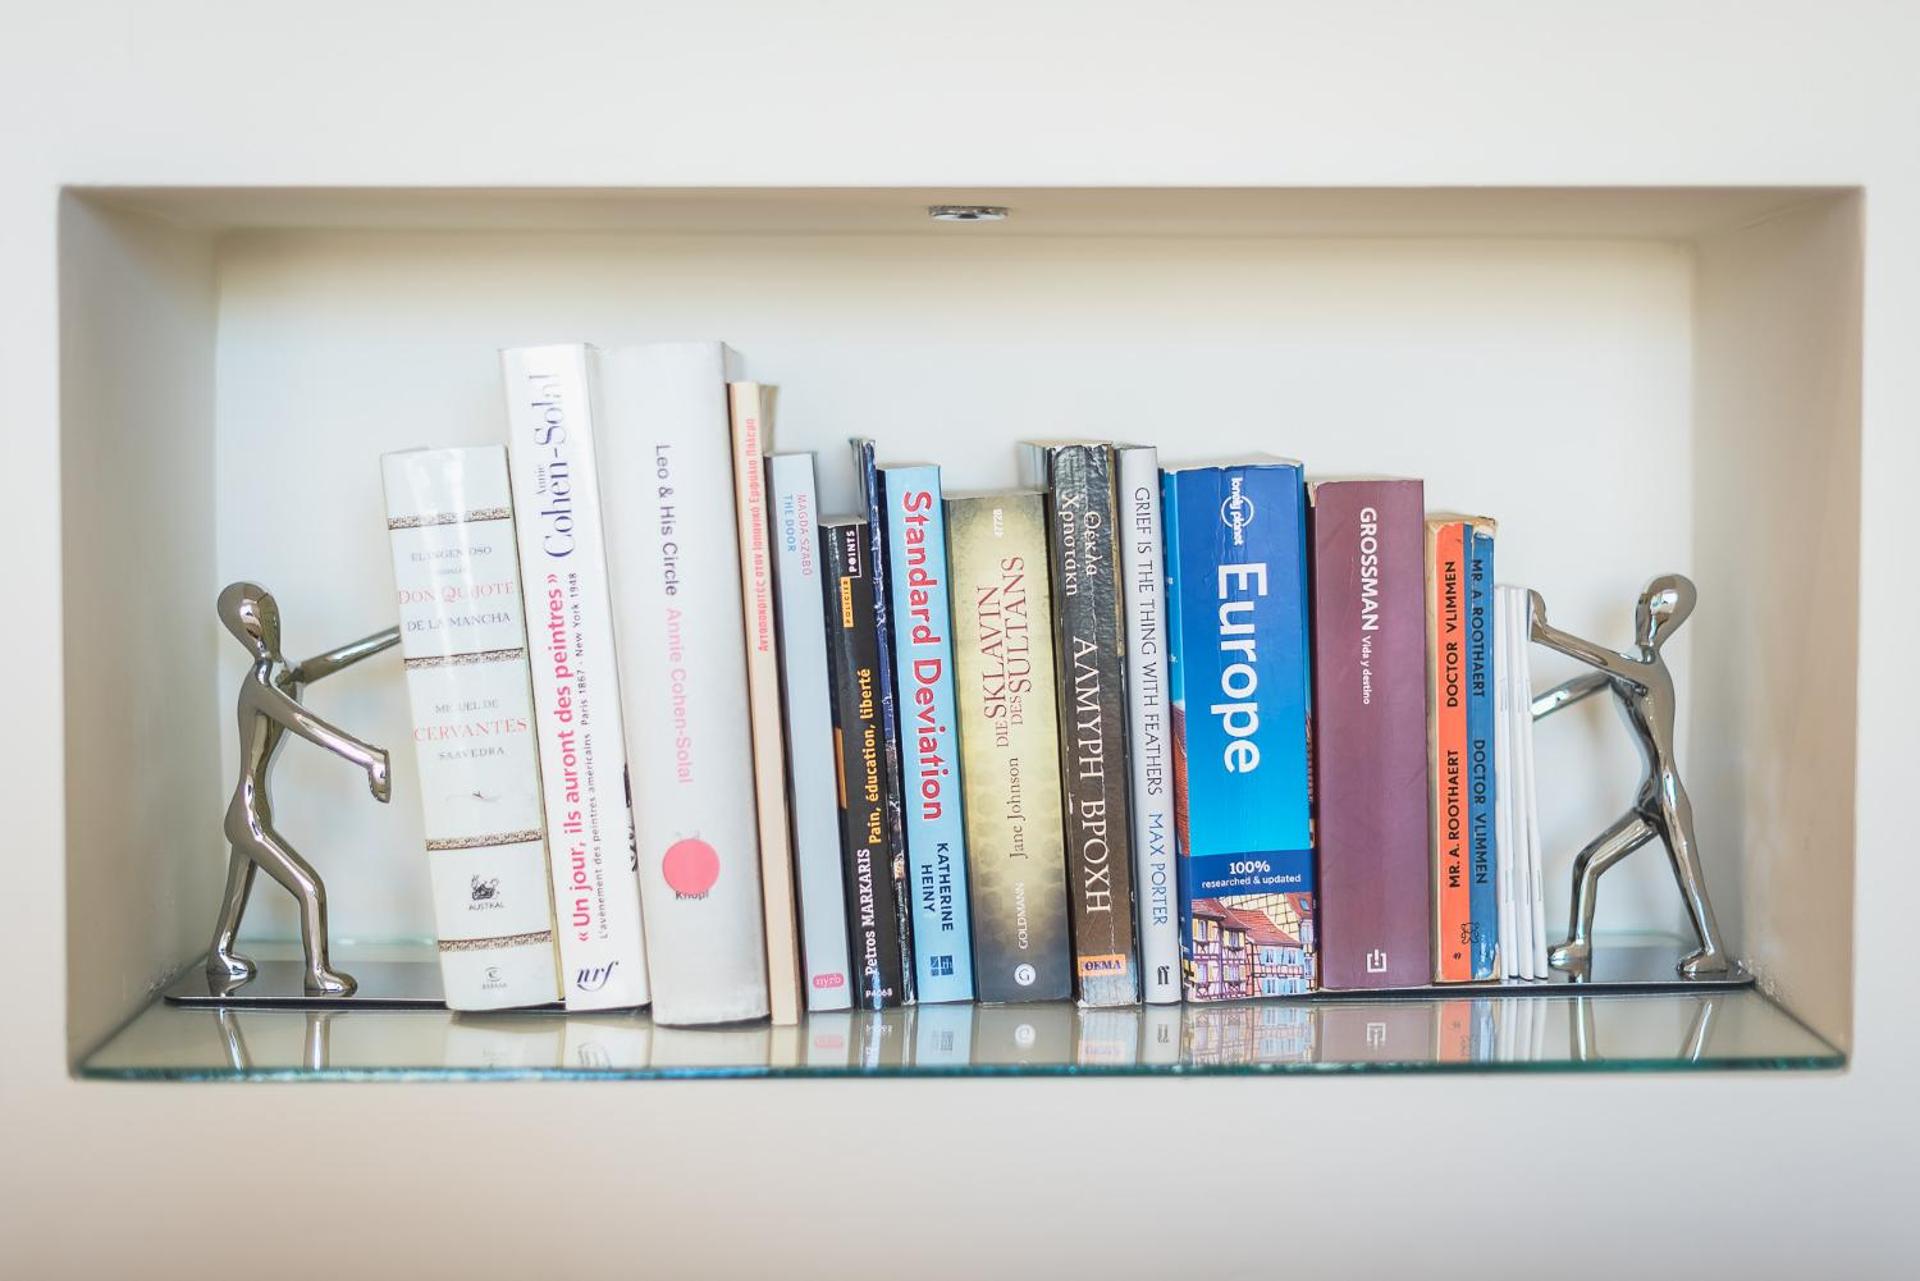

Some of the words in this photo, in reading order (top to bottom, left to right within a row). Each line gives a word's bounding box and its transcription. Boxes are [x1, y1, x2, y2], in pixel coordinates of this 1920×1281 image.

[528, 373, 575, 557] Cohen-Solal
[656, 444, 670, 479] Leo
[659, 486, 673, 498] &
[783, 495, 794, 516] THE
[1135, 487, 1152, 535] GRIEF
[1229, 477, 1244, 510] lonely
[660, 506, 675, 535] His
[797, 494, 809, 536] MAGDA
[1229, 510, 1245, 546] planet
[785, 520, 796, 553] DOOR
[846, 531, 857, 573] POINTS
[1137, 541, 1153, 555] IS
[568, 572, 578, 598] 1948
[663, 542, 679, 596] Circle
[903, 491, 942, 645] Standard
[1138, 560, 1154, 593] THE
[1360, 506, 1379, 631] GROSSMAN
[571, 604, 582, 628] York
[1445, 561, 1457, 633] VLIMMEN
[449, 612, 512, 628] MANCHA
[548, 589, 575, 679] peintres
[666, 608, 683, 662] Annie
[1000, 556, 1031, 694] SULTANS
[1139, 599, 1157, 655] THING
[575, 633, 584, 657] New
[976, 586, 1007, 719] SKLAVIN
[1361, 635, 1372, 658] Vida
[1472, 608, 1485, 698] ROOTHAERT
[577, 670, 587, 694] 1867
[1142, 663, 1158, 707] WITH
[1210, 562, 1268, 774] Europe
[1361, 667, 1372, 705] destino
[1446, 642, 1458, 707] DOCTOR
[554, 686, 573, 723] des
[580, 701, 590, 726] Paris
[857, 668, 874, 720] liberté
[1009, 695, 1024, 726] DES
[413, 718, 528, 743] CERVANTES
[671, 668, 693, 783] Cohen-Solal
[913, 658, 949, 821] Deviation
[996, 721, 1009, 748] DIE
[557, 730, 582, 803] auront
[863, 724, 877, 802] éducation,
[1143, 713, 1163, 796] FEATHERS
[1473, 739, 1487, 804] DOCTOR
[1006, 757, 1026, 821] Johnson
[1447, 750, 1460, 840] ROOTHAERT
[564, 811, 582, 834] ils
[588, 797, 602, 842] peintres
[868, 807, 882, 844] Pain,
[1149, 813, 1165, 857] MAX
[594, 846, 603, 865] des
[1009, 825, 1028, 859] Jane
[1448, 844, 1460, 857] A.
[1474, 813, 1488, 884] VLIMMEN
[568, 841, 593, 891] jour,
[936, 842, 954, 932] KATHERINE
[1202, 875, 1251, 889] researched
[1253, 876, 1261, 885] &
[1263, 874, 1301, 886] updated
[1229, 861, 1271, 875] 100%
[1448, 862, 1460, 888] MR.
[857, 848, 876, 928] MARKARIS
[921, 864, 936, 912] HEINY
[1150, 863, 1168, 926] PORTER
[573, 899, 592, 928] Un
[1015, 880, 1029, 950] GOLDMANN
[865, 931, 877, 976] Petros
[576, 961, 618, 992] nrf
[816, 975, 841, 987] nyrb
[1157, 965, 1170, 986] ff
